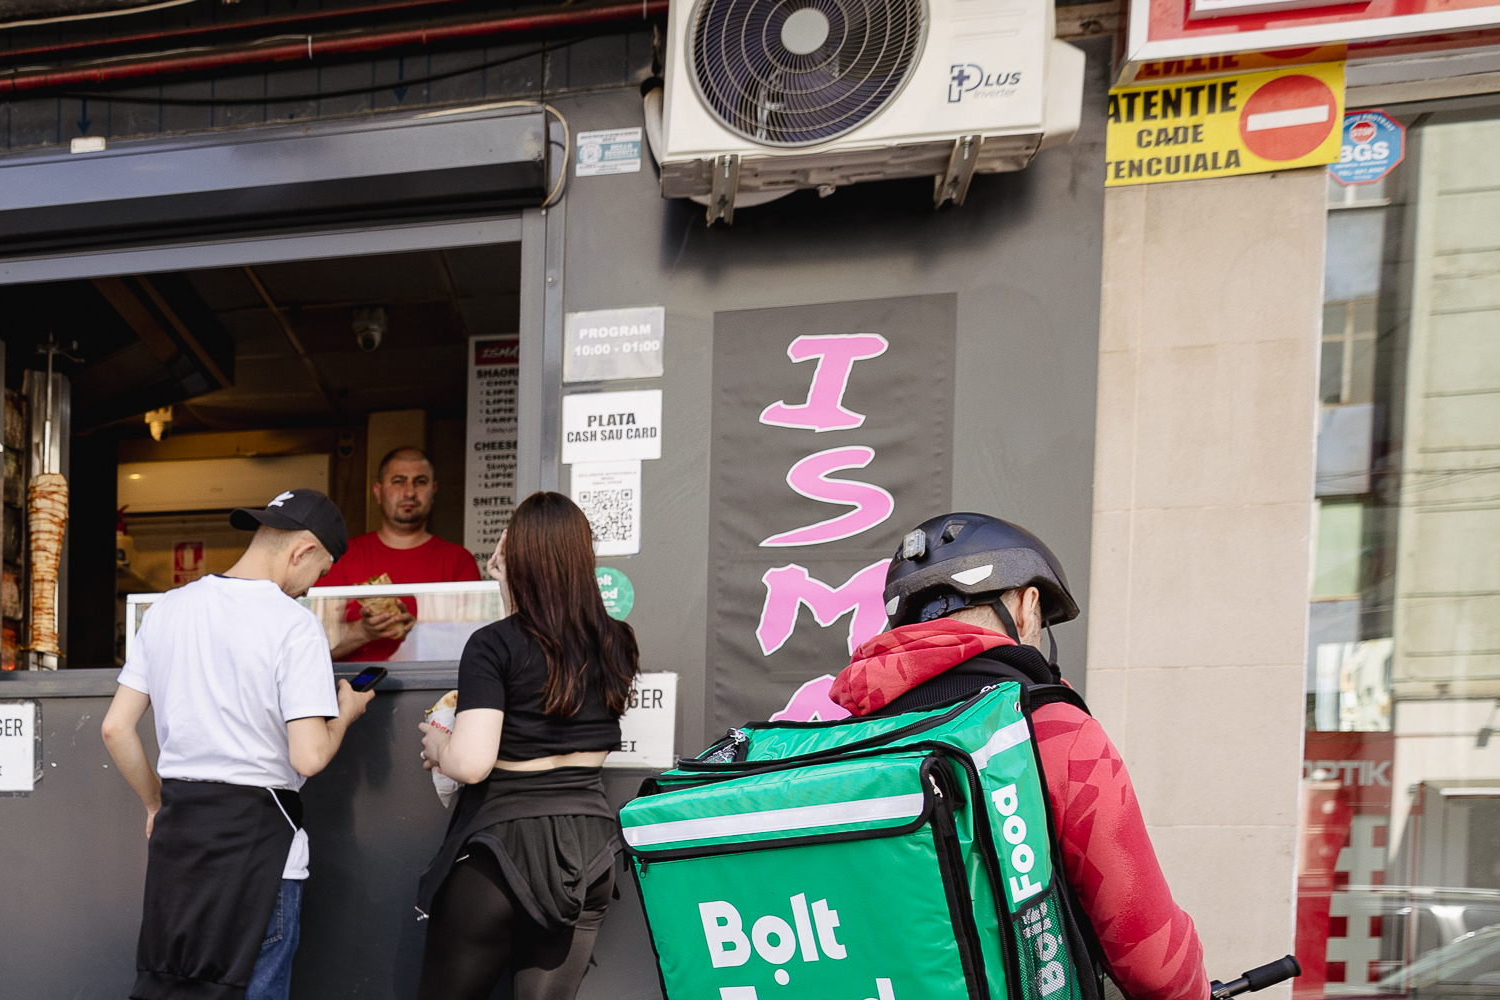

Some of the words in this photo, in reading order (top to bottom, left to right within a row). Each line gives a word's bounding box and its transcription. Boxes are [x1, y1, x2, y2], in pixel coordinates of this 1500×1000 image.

[1107, 80, 1238, 124] ATENTIE
[1136, 123, 1204, 149] CADE
[1340, 141, 1390, 162] BGS
[579, 324, 651, 339] PROGRAM
[574, 343, 611, 356] 10:00
[622, 340, 660, 353] 01:00
[587, 412, 636, 427] PLATA
[567, 431, 597, 443] CASH
[600, 429, 622, 441] SAU
[626, 427, 657, 439] CARD
[597, 574, 612, 586] olt
[991, 783, 1043, 904] Food
[698, 892, 848, 970] Bolt
[1021, 900, 1066, 998] Bolt
